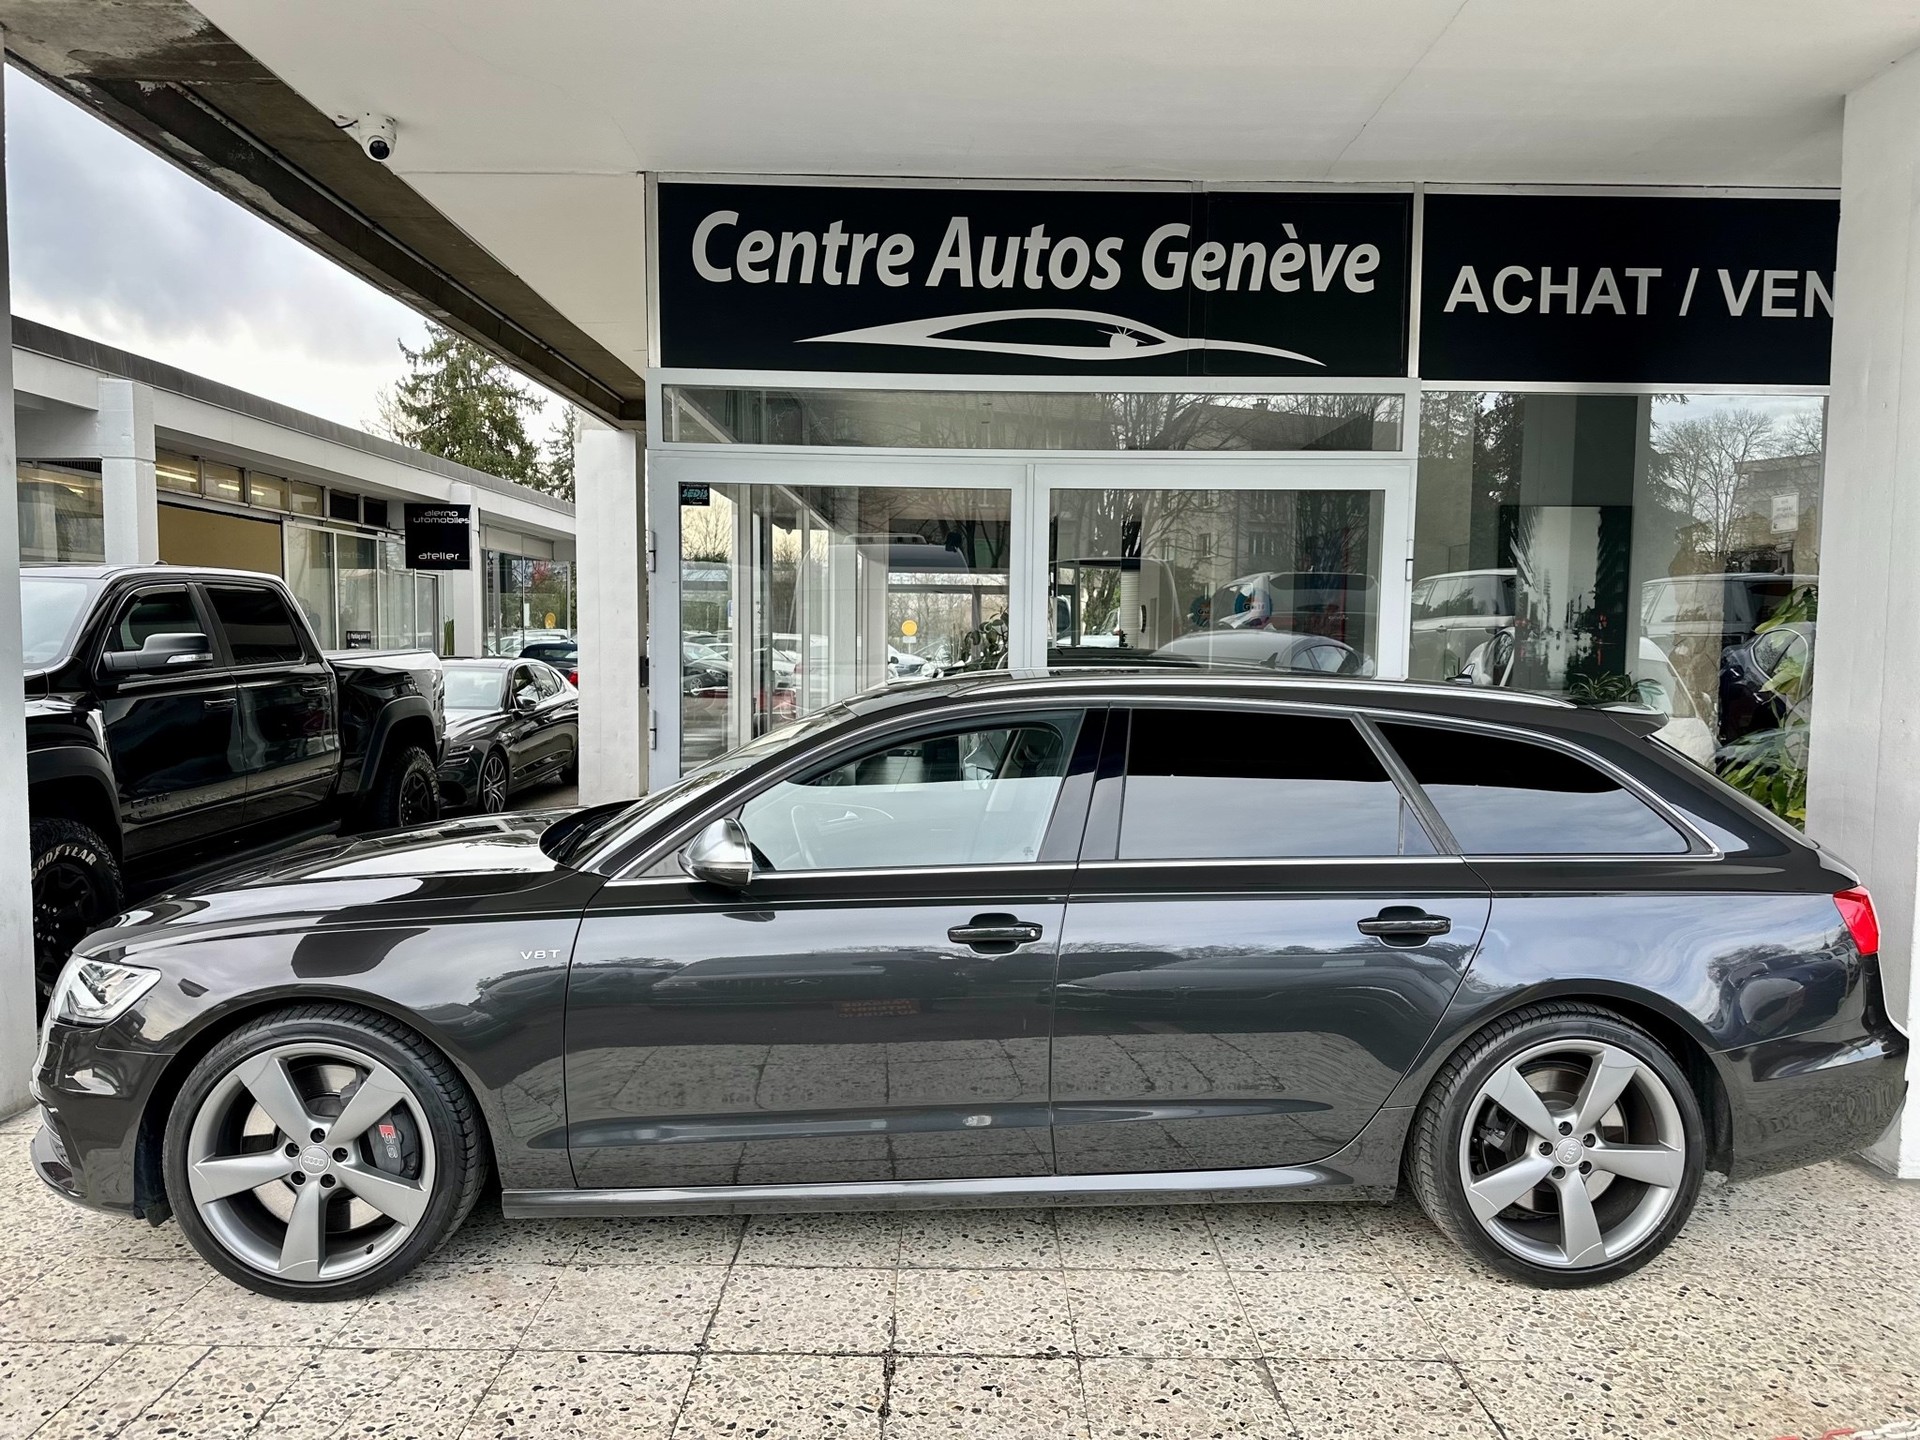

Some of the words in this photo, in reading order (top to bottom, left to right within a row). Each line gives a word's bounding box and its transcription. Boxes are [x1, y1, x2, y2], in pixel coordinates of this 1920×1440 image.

[692, 210, 915, 287] Centre
[925, 216, 1124, 291] Autos
[1142, 222, 1380, 293] Genève
[1443, 265, 1662, 315] ACHAT
[1678, 268, 1699, 316] /
[1717, 269, 1836, 318] VEN
[418, 551, 460, 560] atelier
[31, 844, 98, 880] OODYEAR
[520, 949, 561, 960] V8T
